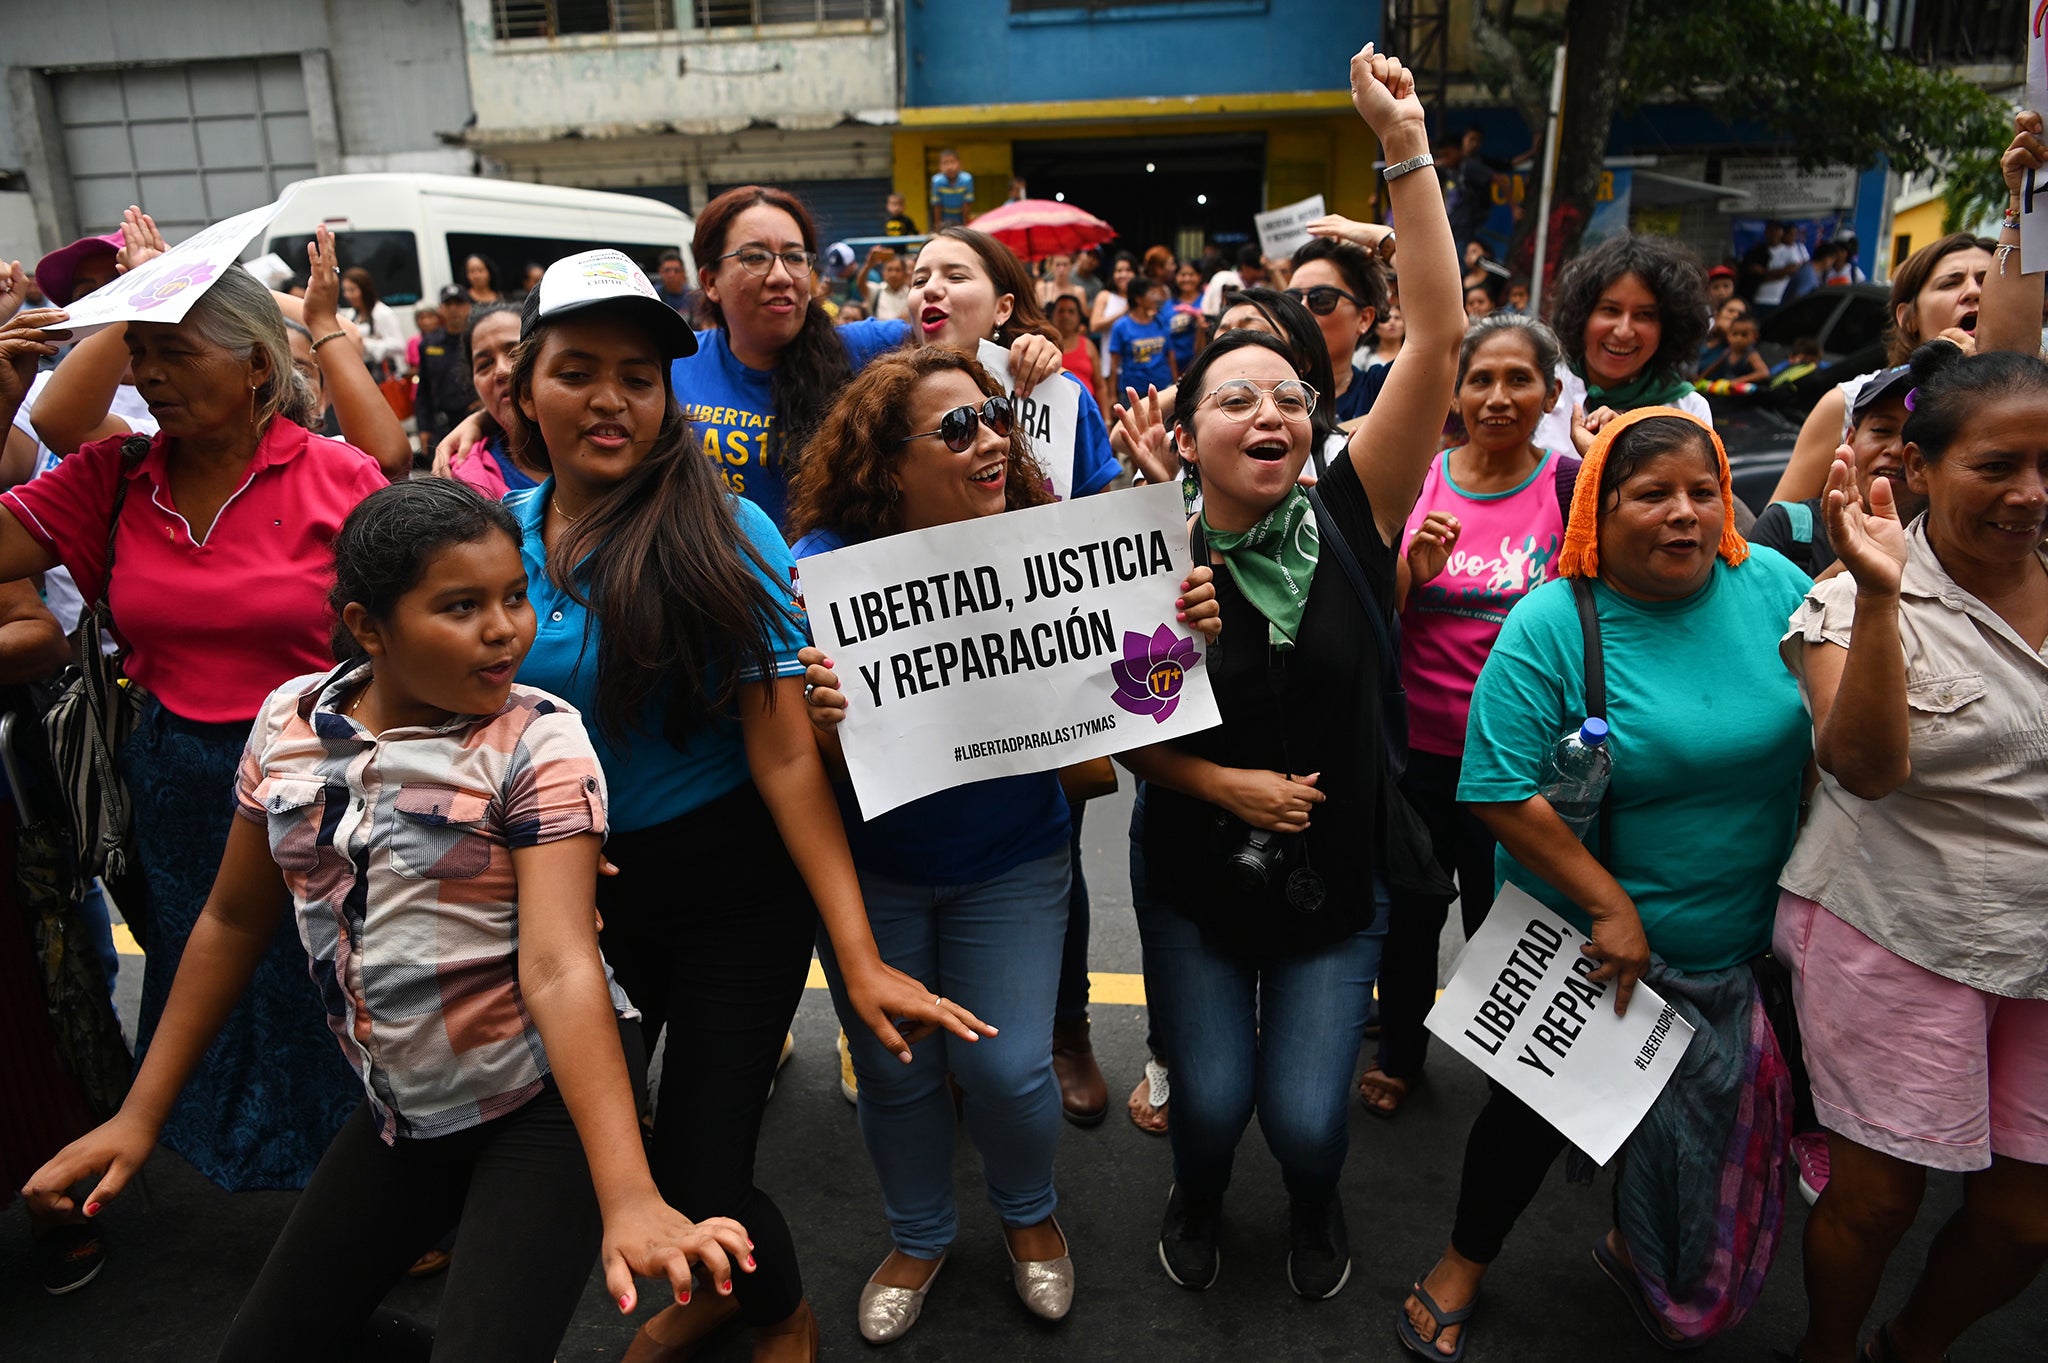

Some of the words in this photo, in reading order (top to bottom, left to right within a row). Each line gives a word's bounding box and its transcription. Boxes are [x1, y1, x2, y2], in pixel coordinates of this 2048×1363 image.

[1010, 391, 1050, 444] ARA
[829, 565, 1015, 648] LIBERTAD,
[1023, 529, 1175, 604] JUSTICIA
[859, 660, 884, 709] Y
[890, 607, 1118, 699] REPARACIÓN
[1150, 667, 1181, 694] 17+
[954, 714, 1117, 763] #LIBERTADPARALAS17YMAS
[1464, 918, 1574, 1056] LIBERTAD,
[1532, 955, 1608, 1059] REPAR
[1517, 1044, 1555, 1078] Y
